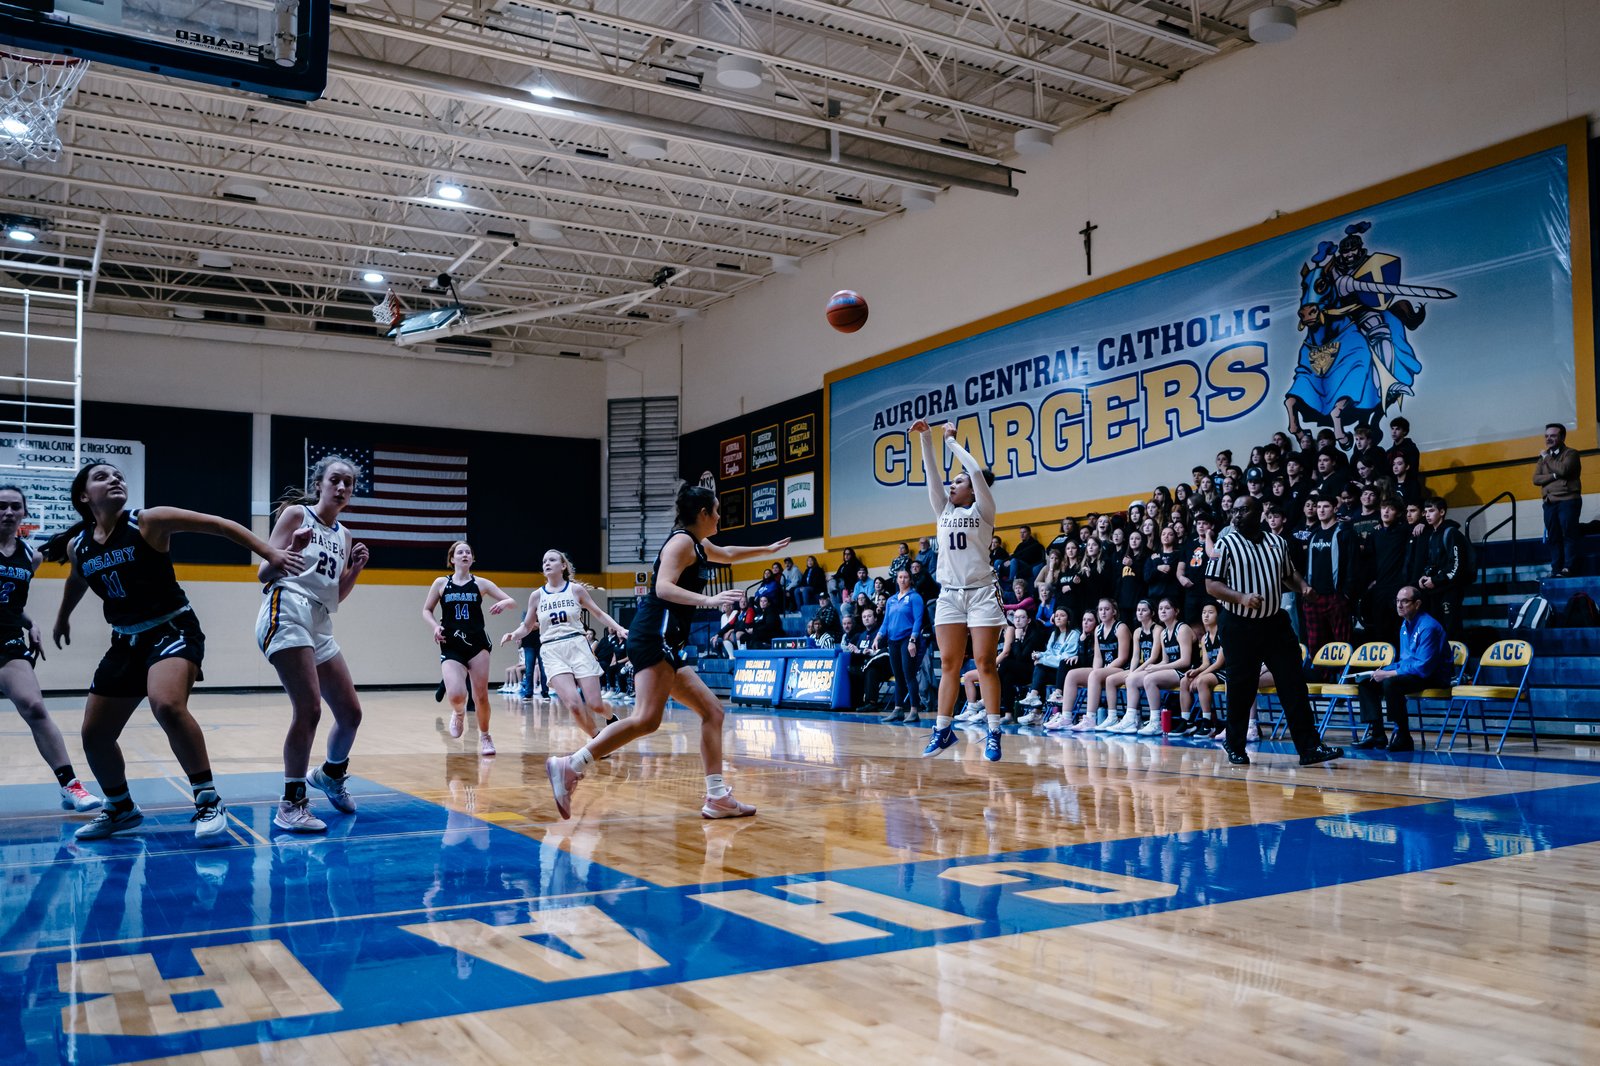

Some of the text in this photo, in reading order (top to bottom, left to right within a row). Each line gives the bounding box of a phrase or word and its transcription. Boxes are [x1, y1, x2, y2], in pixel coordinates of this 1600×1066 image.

[872, 305, 1271, 431] AURORA CENTRAL CATHOLIC
[872, 340, 1270, 487] CHARGERS
[105, 443, 133, 455] SCHOOL
[18, 453, 71, 464] SCHOOL
[755, 506, 773, 520] Knights
[949, 532, 967, 550] 10
[82, 546, 135, 577] ROSARY
[316, 552, 337, 580] 23
[0, 564, 31, 581] SARY
[102, 571, 126, 598] 11
[444, 592, 478, 603] ROSARY
[540, 599, 575, 612] CHARGERS
[455, 603, 469, 620] 14
[550, 610, 567, 625] 20
[1320, 645, 1347, 660] ACC
[1357, 645, 1388, 661] ACC
[1490, 642, 1526, 660] ACC
